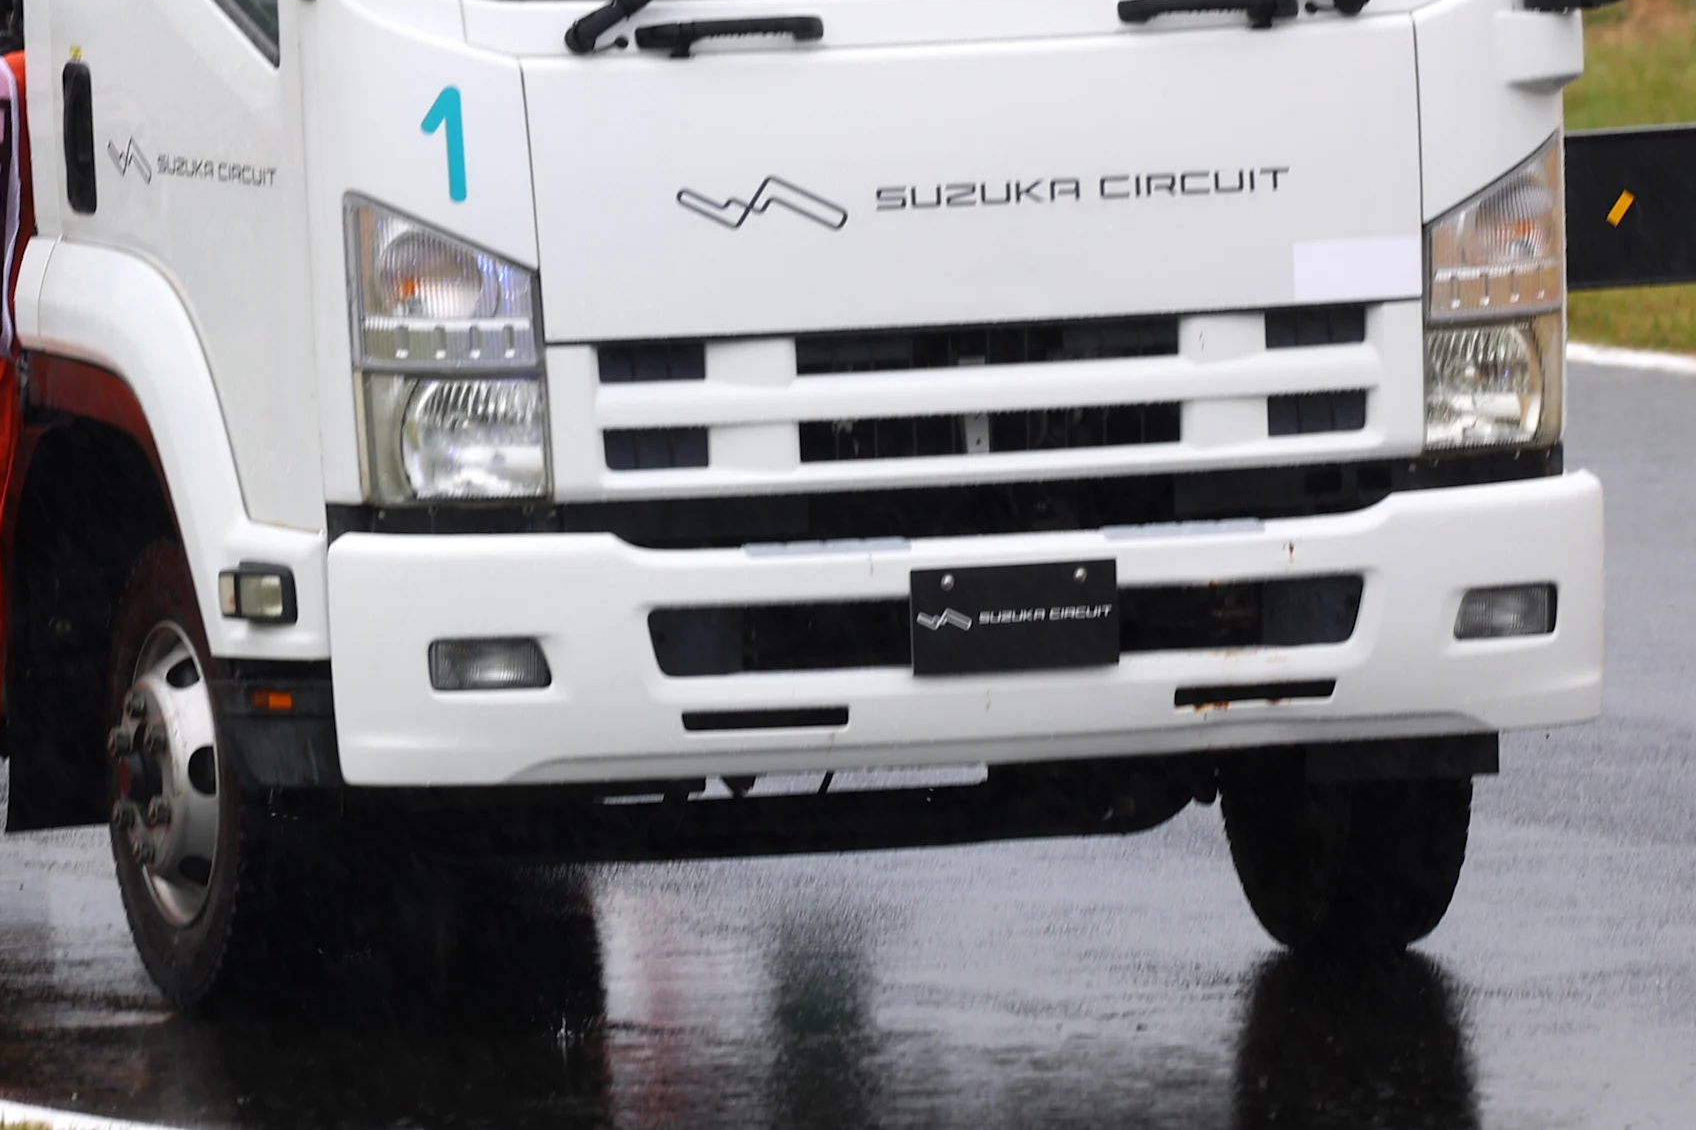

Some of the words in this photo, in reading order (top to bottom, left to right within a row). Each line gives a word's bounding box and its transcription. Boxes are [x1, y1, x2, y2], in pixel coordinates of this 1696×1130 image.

[420, 84, 467, 204] 1
[157, 153, 214, 180] SUZUKA
[217, 161, 277, 187] CIRCUIT
[875, 177, 1081, 212] SUZUKA
[1098, 166, 1290, 201] CIRCUIT
[979, 607, 1046, 625] SUZUKA
[1048, 603, 1113, 621] CIRCUIT
